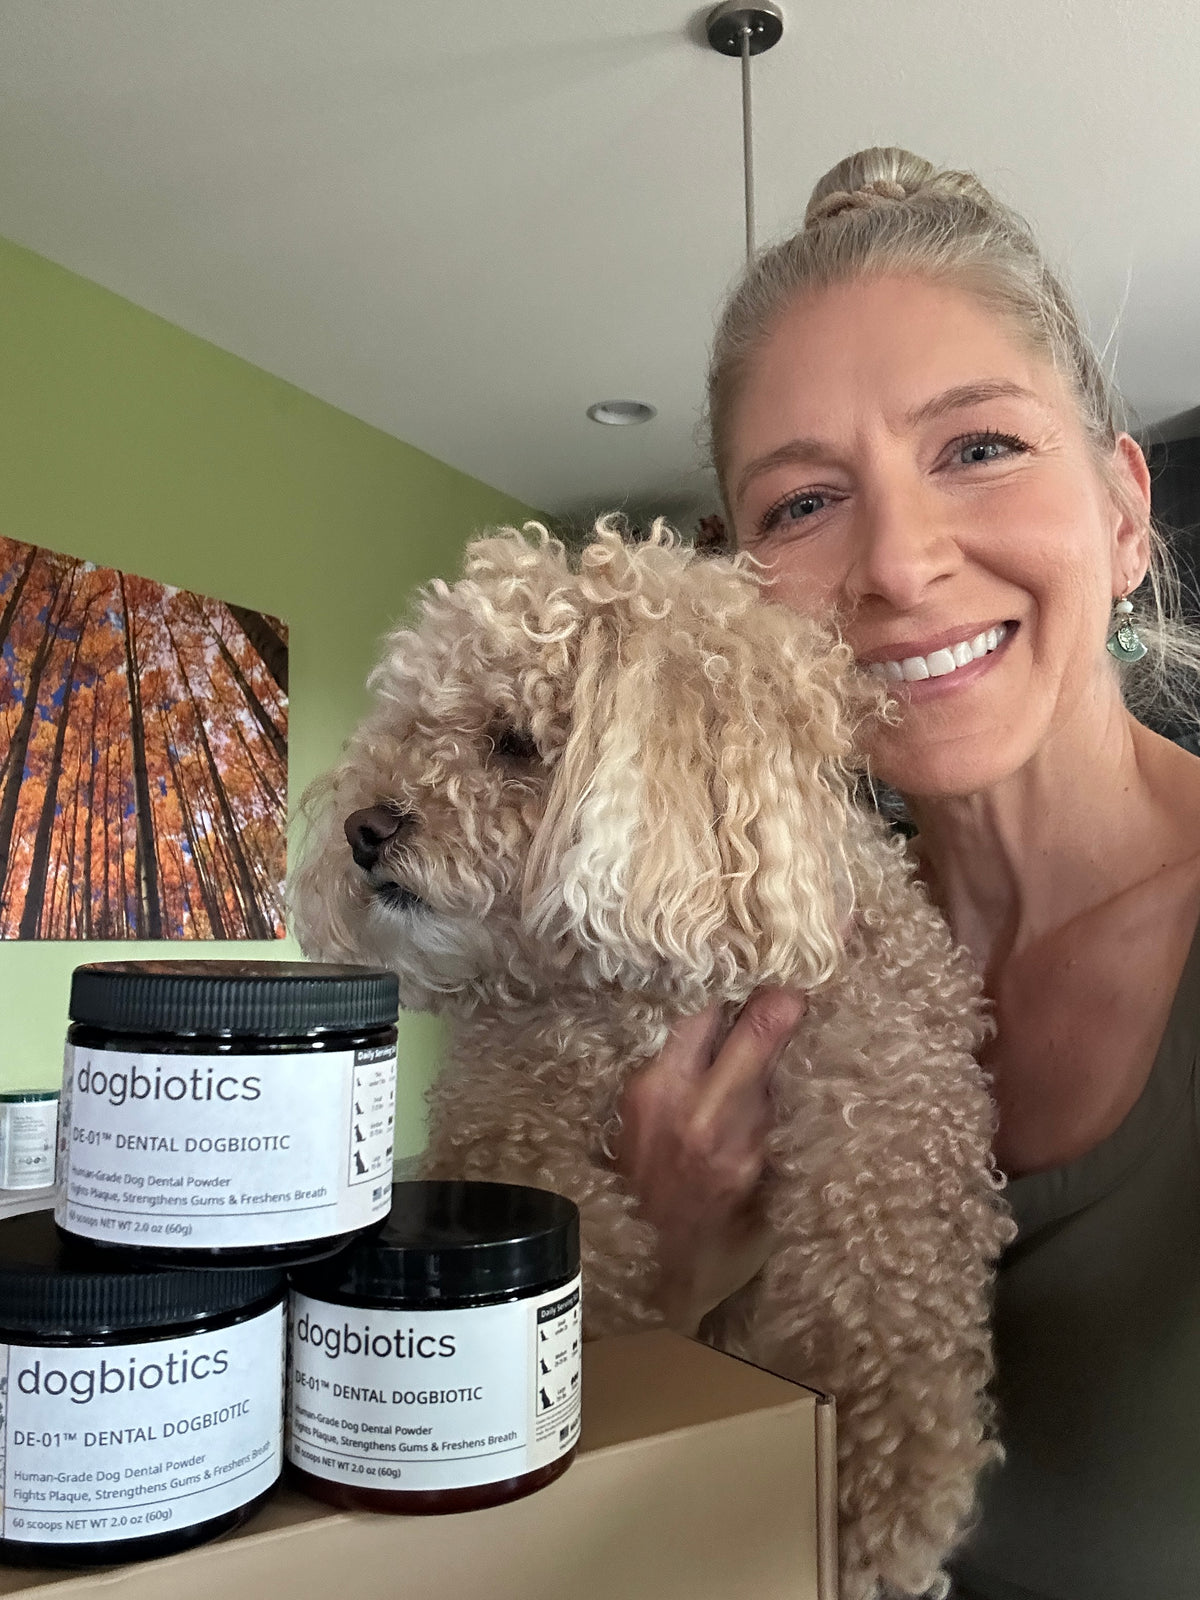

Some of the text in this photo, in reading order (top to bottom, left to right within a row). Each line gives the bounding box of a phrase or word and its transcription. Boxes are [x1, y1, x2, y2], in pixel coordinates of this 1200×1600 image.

[77, 1061, 261, 1106] dogbiotics
[116, 1134, 179, 1152] DENTAL
[185, 1135, 291, 1152] DOGBIOTIC
[124, 1173, 144, 1188] Dog
[147, 1176, 183, 1187] Dental
[187, 1176, 231, 1187] Powder
[123, 1192, 188, 1207] Strengthens
[191, 1195, 225, 1206] Gums
[228, 1194, 238, 1205] &
[240, 1192, 292, 1205] Freshens
[294, 1185, 328, 1201] Breath
[100, 1217, 116, 1229] NET
[118, 1220, 133, 1231] WT
[134, 1222, 149, 1232] 2.0
[151, 1224, 163, 1232] oz
[165, 1223, 192, 1236] (60g)
[541, 1307, 556, 1318] Daily
[298, 1313, 456, 1359] dogbiotics
[18, 1349, 228, 1404] dogbiotics
[333, 1383, 388, 1404] DENTAL
[392, 1386, 483, 1404] DOGBIOTIC
[84, 1426, 157, 1447] DENTAL
[163, 1399, 250, 1438] DOGBIOTIC
[341, 1420, 359, 1433] Dog
[361, 1423, 392, 1434] Dental
[395, 1425, 432, 1436] Powder
[340, 1436, 396, 1452] Strengthens
[399, 1442, 429, 1452] Gums
[431, 1442, 439, 1452] &
[441, 1439, 485, 1452] Freshens
[488, 1431, 518, 1446] Breath
[14, 1454, 206, 1483] Human-Grade Dog Dental Powder
[14, 1489, 46, 1503] Fights
[49, 1491, 92, 1503] Plaque,
[95, 1482, 167, 1500] Strengthens
[170, 1474, 201, 1489] Gums
[203, 1469, 212, 1480] &
[213, 1453, 250, 1477] Freshens
[322, 1456, 336, 1468] NET
[337, 1460, 351, 1471] WT
[352, 1463, 365, 1473] 2.0
[366, 1466, 376, 1474] oz
[378, 1467, 401, 1479] (60g)
[12, 1507, 173, 1532] 60 scoops NET WT 2.0 oz (60g)
